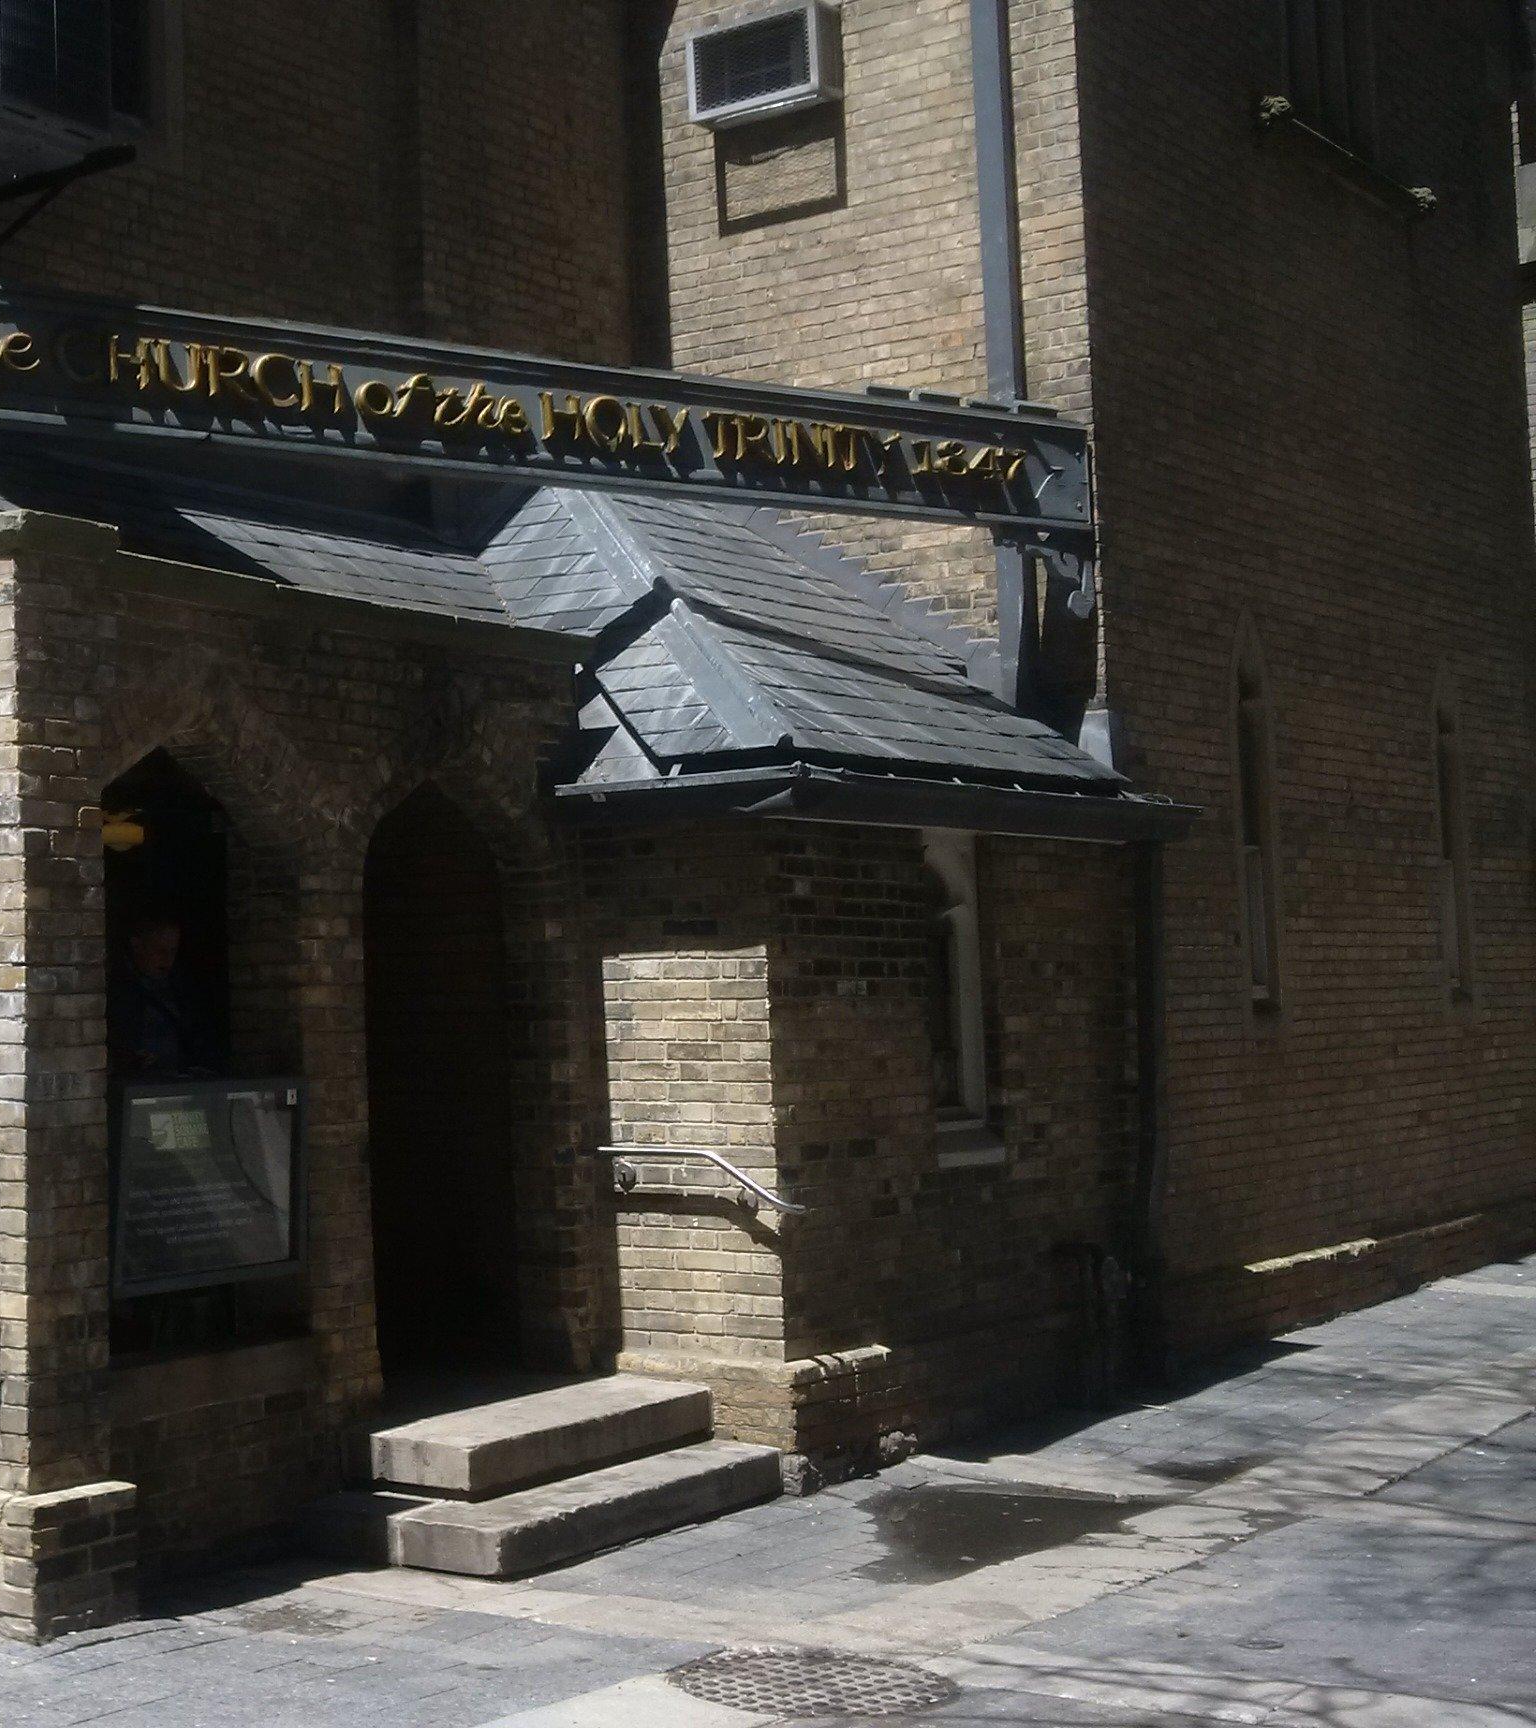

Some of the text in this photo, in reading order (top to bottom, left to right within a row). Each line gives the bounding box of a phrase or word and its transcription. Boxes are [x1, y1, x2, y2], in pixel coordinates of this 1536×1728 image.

[353, 372, 433, 418] of
[433, 382, 539, 434] the
[538, 391, 691, 455] HOLY
[910, 437, 1027, 481] 1847
